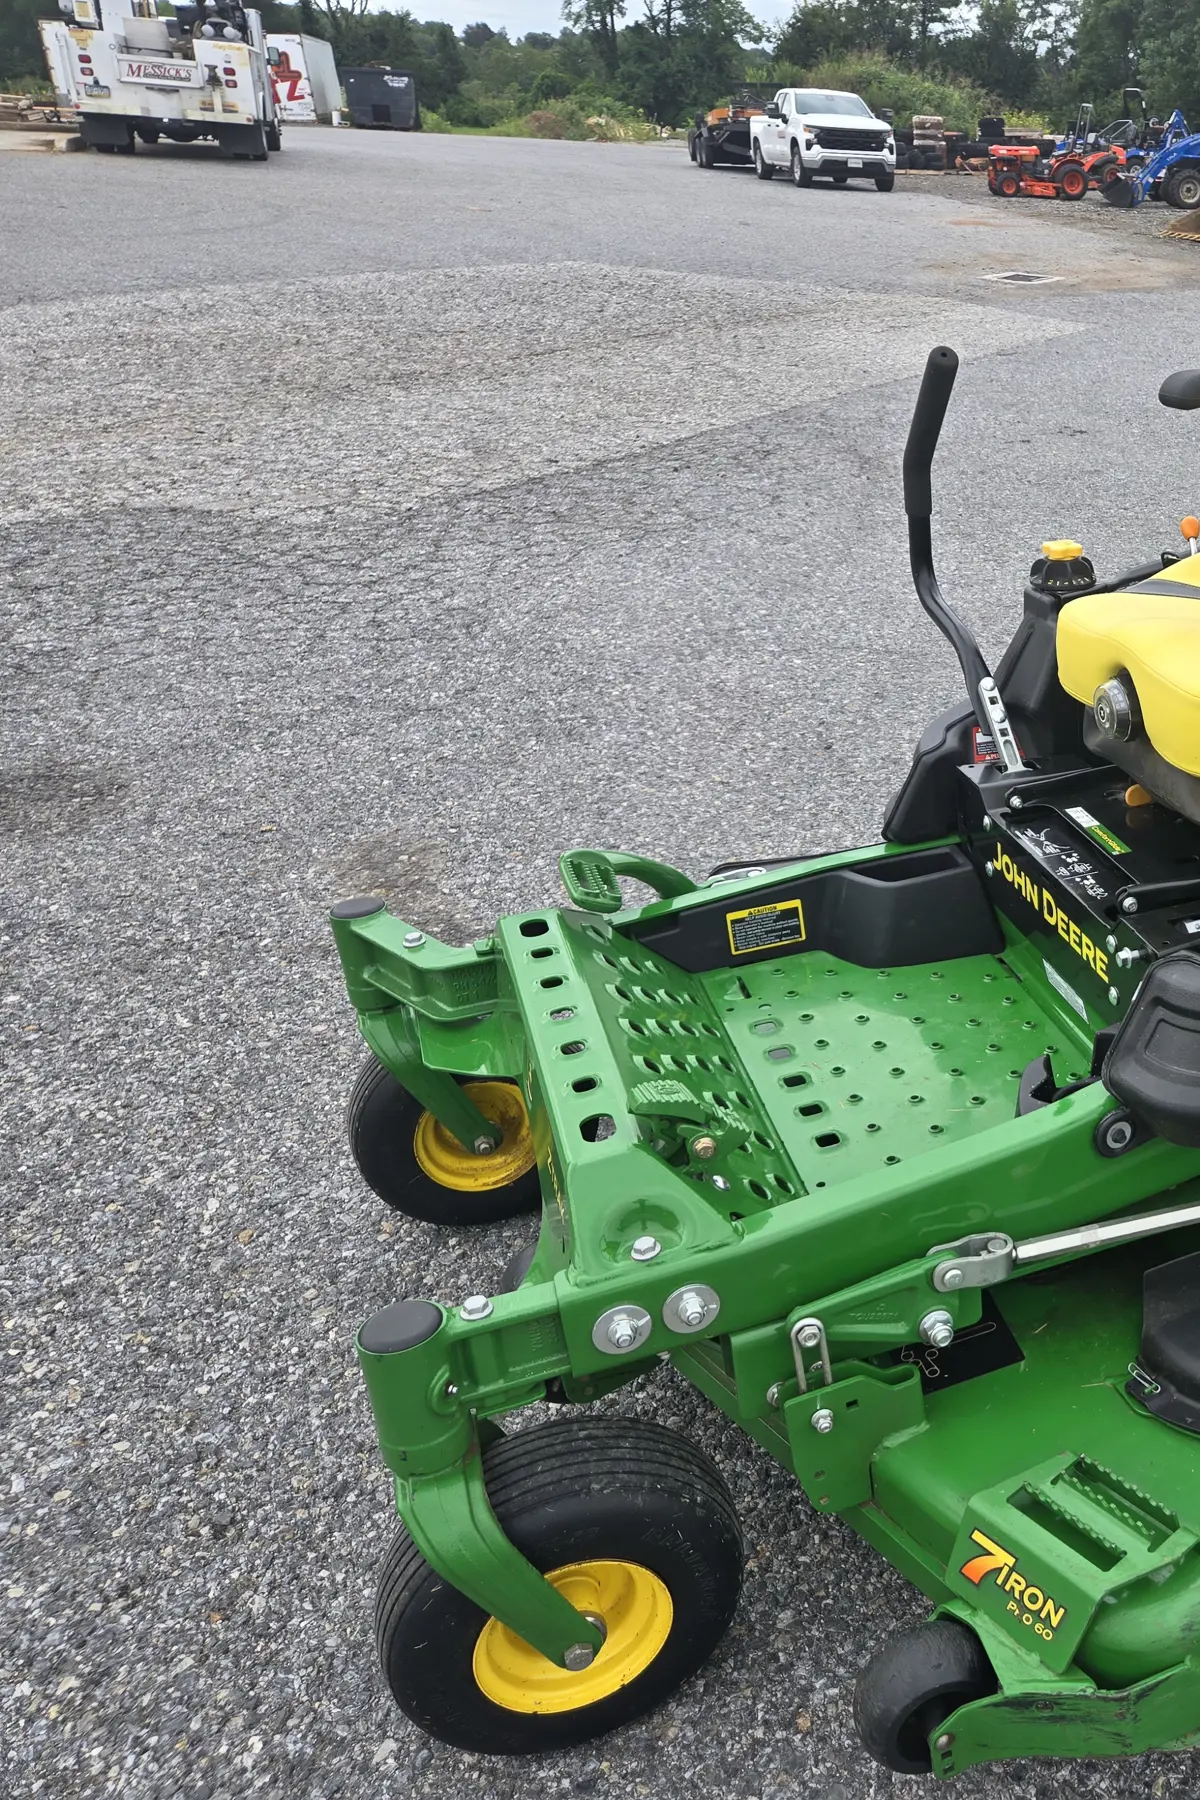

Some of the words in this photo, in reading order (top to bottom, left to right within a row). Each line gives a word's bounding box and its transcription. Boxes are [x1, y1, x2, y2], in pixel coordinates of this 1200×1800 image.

[126, 63, 192, 78] MESSICK'S
[753, 905, 777, 914] CAUTION
[993, 842, 1039, 911] JOHN
[1043, 887, 1109, 984] DEERE
[1034, 1622, 1053, 1641] 60
